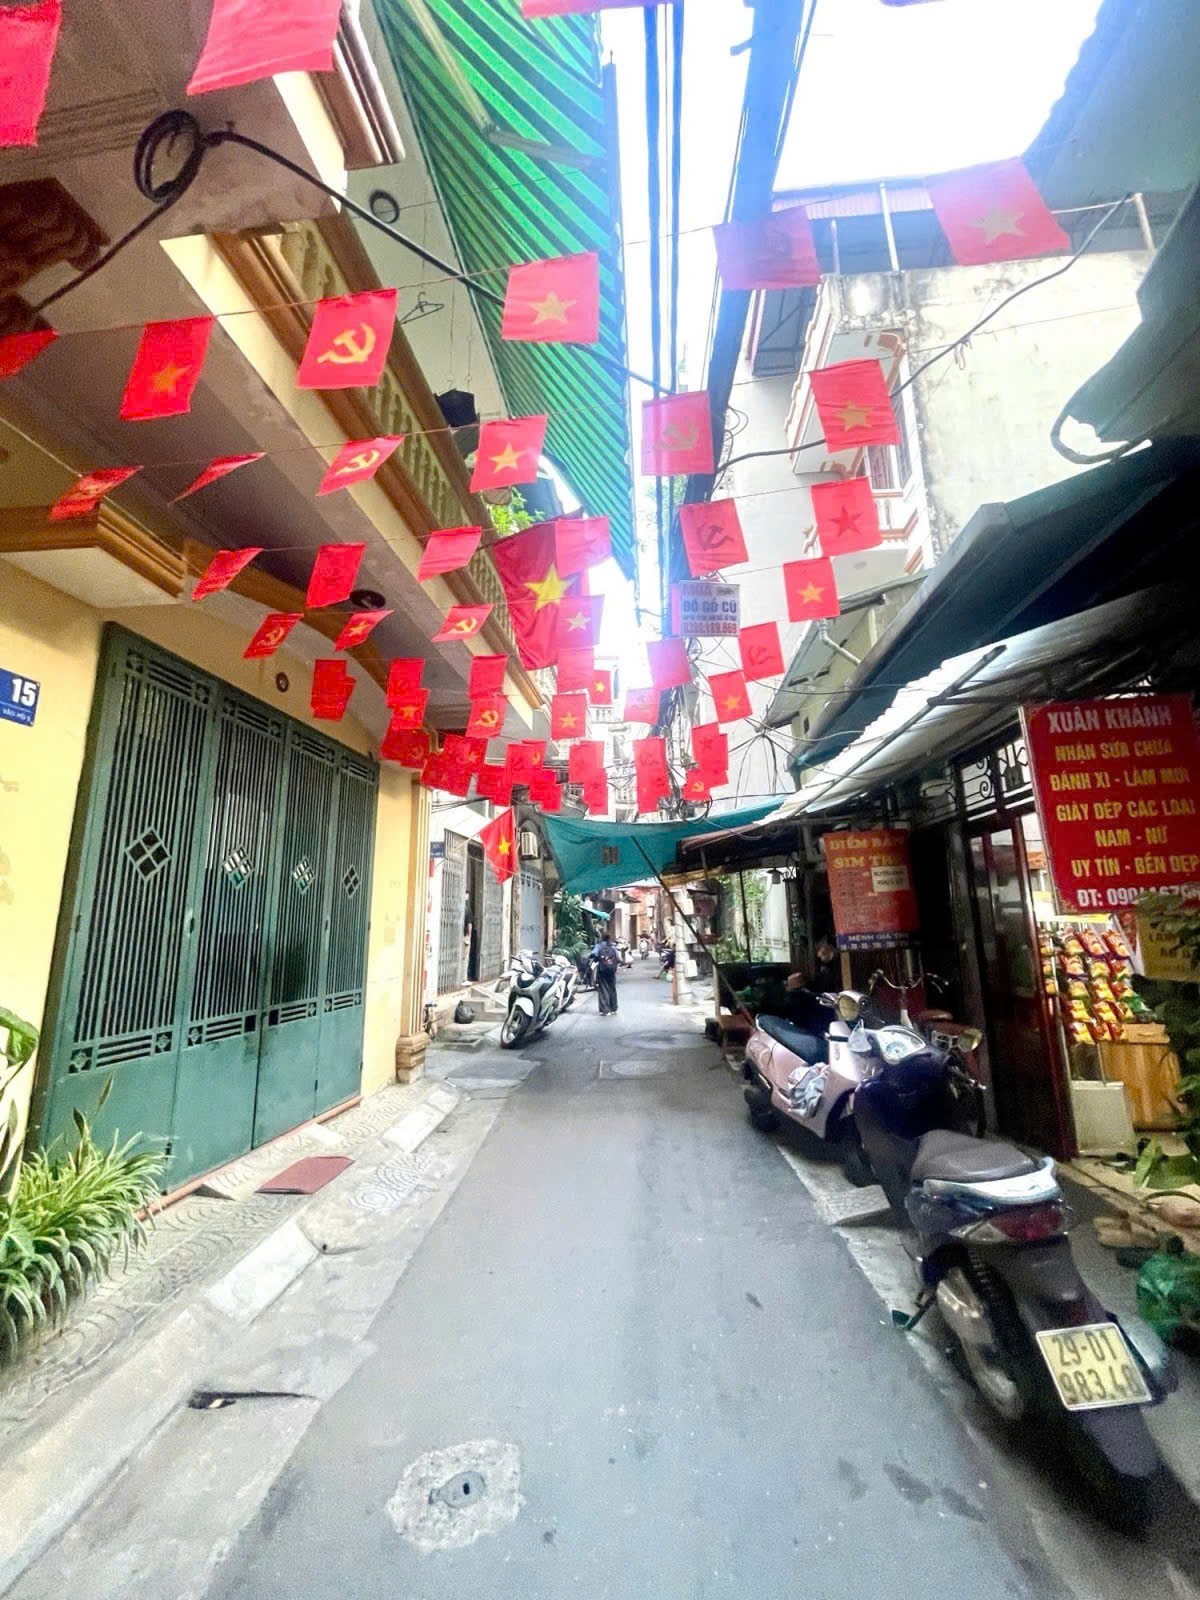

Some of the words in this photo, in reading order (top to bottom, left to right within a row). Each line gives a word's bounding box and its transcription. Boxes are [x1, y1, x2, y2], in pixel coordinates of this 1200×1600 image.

[12, 678, 37, 707] 15
[1048, 706, 1099, 733] XUÂN
[1105, 703, 1172, 729] KHÁNH
[1055, 742, 1096, 764] NHẬN
[1050, 770, 1091, 791] ĐÁNH
[1124, 765, 1156, 786] LÀM
[1095, 829, 1131, 847] NAM
[833, 856, 865, 869] SIM
[1071, 857, 1091, 877] UY
[1095, 855, 1120, 876] TÍN
[1077, 888, 1103, 907] ĐT:
[1052, 1329, 1118, 1366] 29-01
